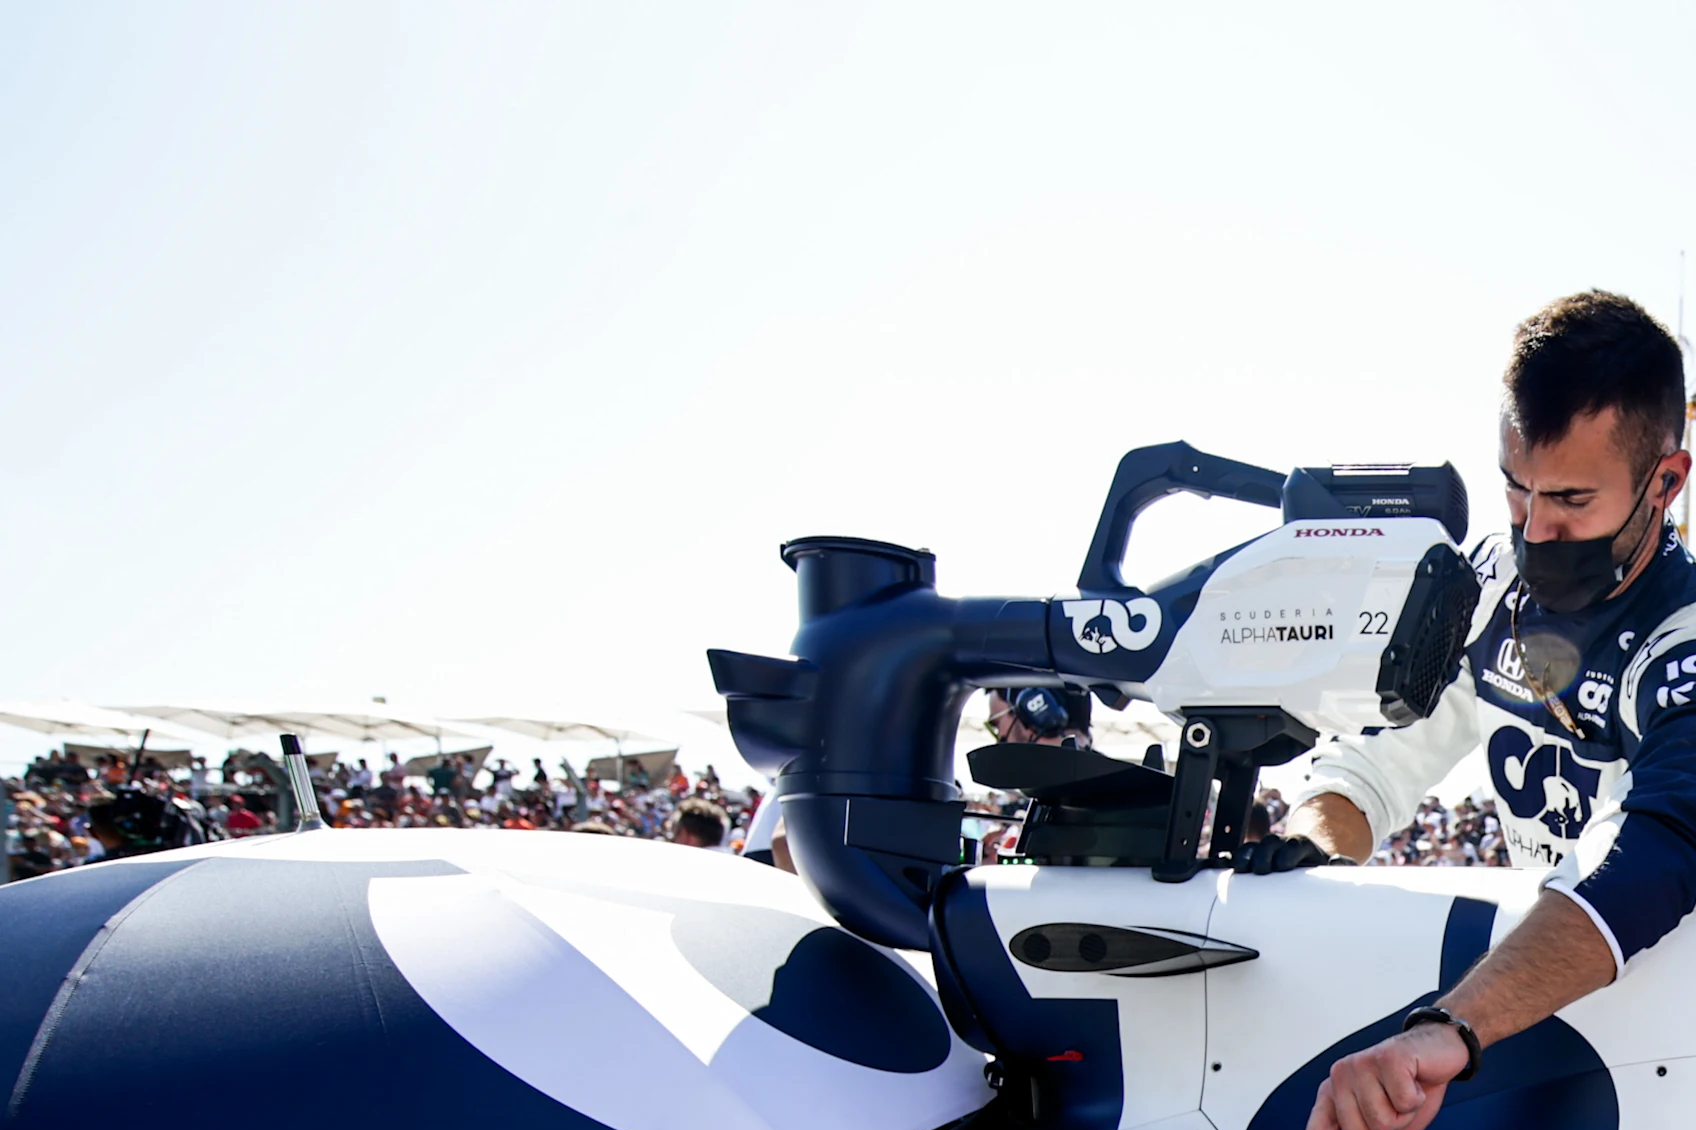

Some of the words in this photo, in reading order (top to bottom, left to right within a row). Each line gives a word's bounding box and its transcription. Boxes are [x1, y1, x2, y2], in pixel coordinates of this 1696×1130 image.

[1294, 528, 1385, 538] HONDA
[1220, 608, 1333, 621] SCUDERIA
[1359, 611, 1389, 635] 22
[1220, 625, 1334, 644] ALPHATAURI
[1481, 668, 1534, 703] HONDA
